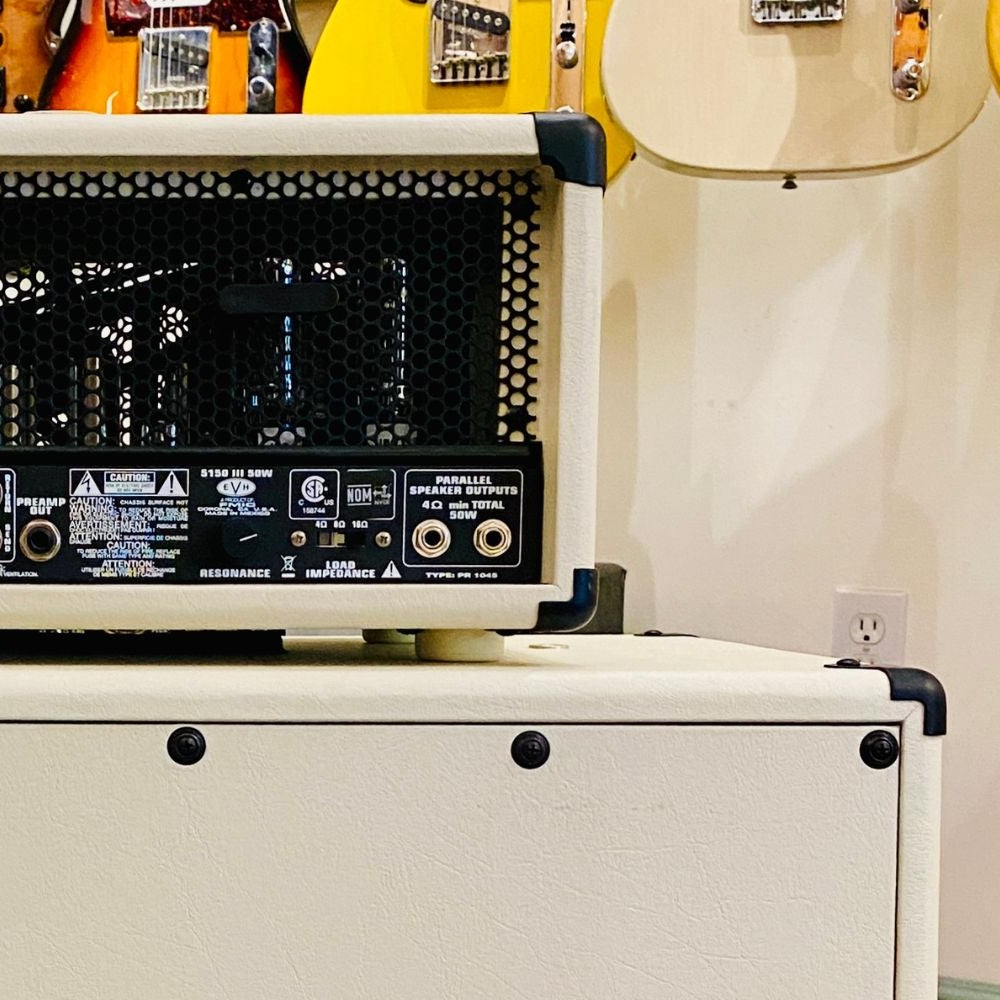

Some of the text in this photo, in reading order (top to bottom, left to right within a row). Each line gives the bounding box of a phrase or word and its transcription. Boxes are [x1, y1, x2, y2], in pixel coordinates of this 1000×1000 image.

[200, 469, 273, 478] 5150 III 50W
[436, 476, 492, 484] PARALLEL
[223, 481, 249, 494] EVH
[409, 486, 518, 495] SPEAKER OUTPUTS
[347, 488, 372, 502] NOM
[17, 498, 66, 507] PREAMP
[70, 497, 115, 505] CAUTION:
[422, 500, 505, 509] 4Ω min TOTAL
[30, 507, 52, 515] OUT
[450, 511, 477, 520] 50W
[69, 520, 150, 529] AVERTISSEMENT:
[69, 532, 122, 540] ATTENTION:
[326, 560, 356, 569] LOAD
[200, 569, 271, 578] RESONANCE
[306, 569, 376, 578] IMPEDANCE
